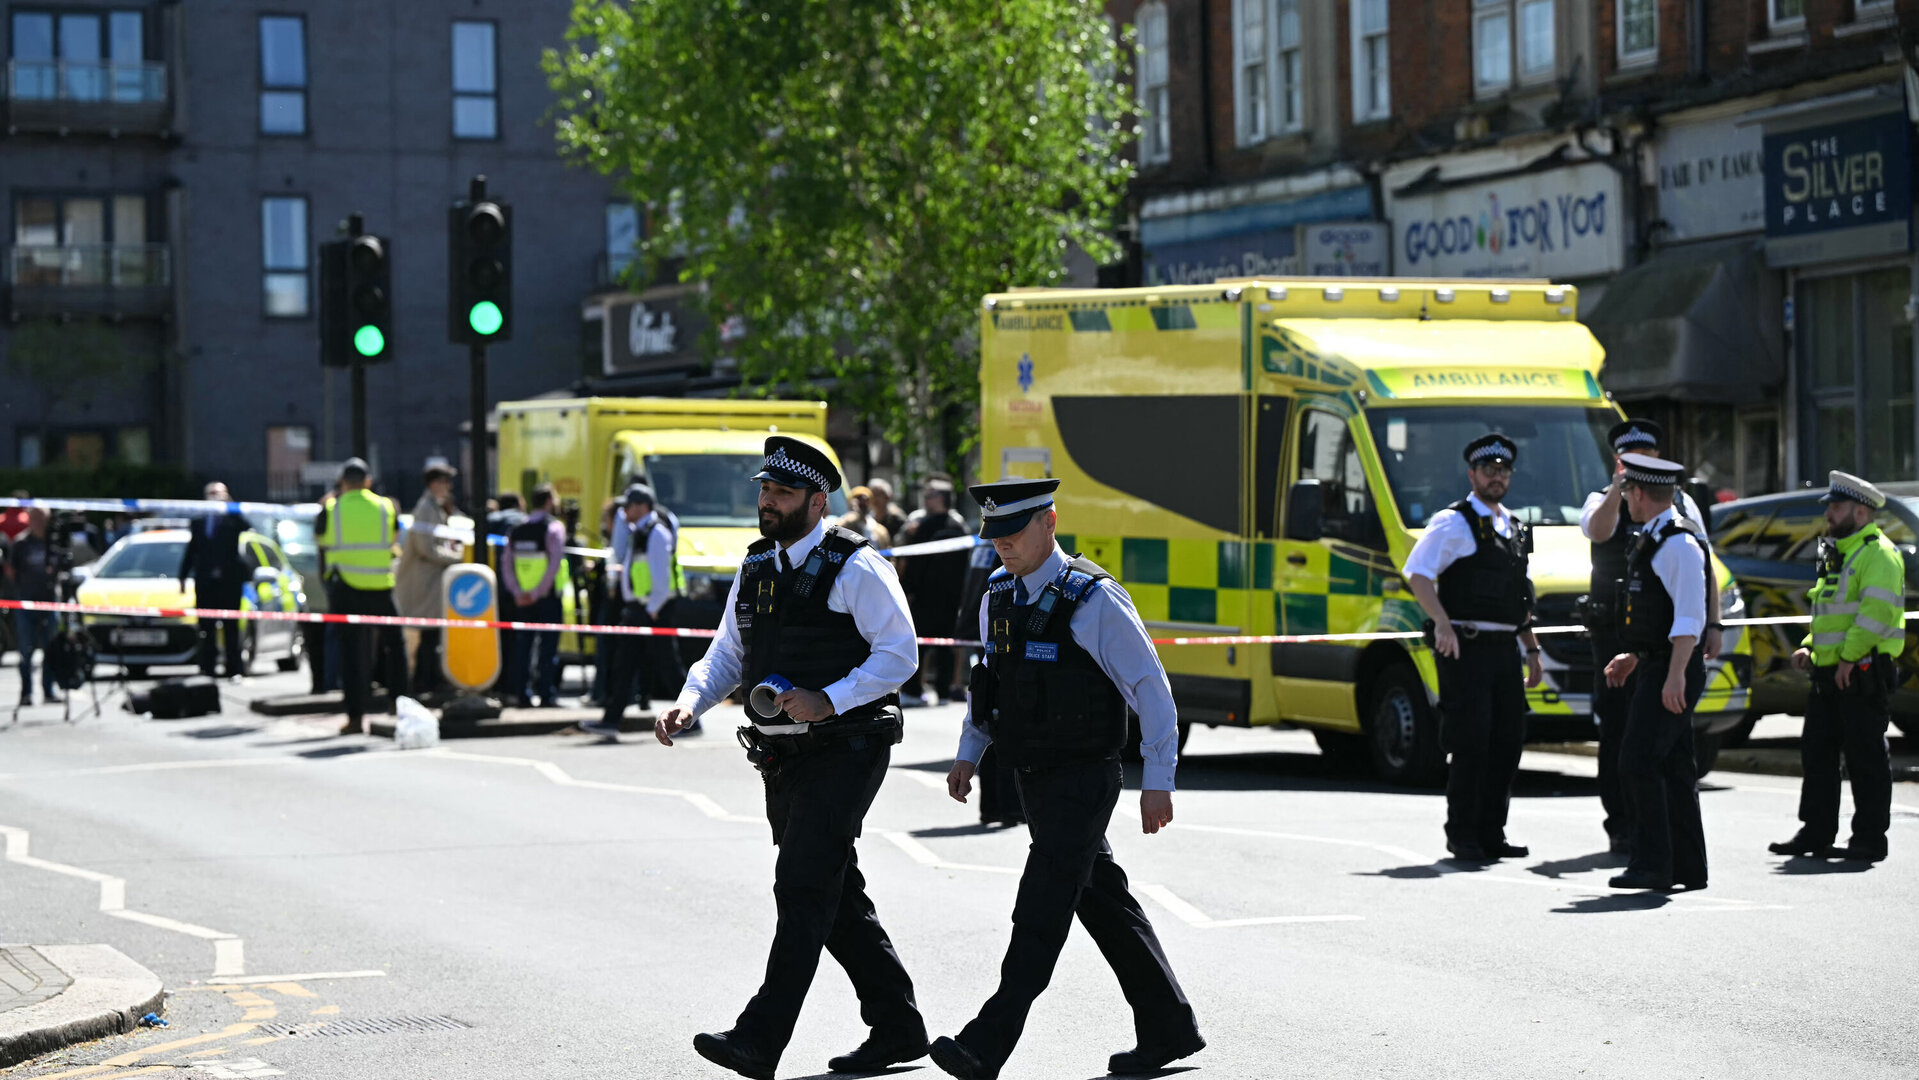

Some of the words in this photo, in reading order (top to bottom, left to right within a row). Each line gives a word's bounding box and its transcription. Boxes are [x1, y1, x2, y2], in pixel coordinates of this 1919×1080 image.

[1812, 137, 1838, 156] THE
[1783, 143, 1884, 202] SILVER
[1783, 192, 1886, 225] PLACE
[1319, 229, 1372, 245] GOOD
[1406, 216, 1473, 264] GOOD
[1506, 200, 1554, 252] FOR
[1557, 191, 1606, 248] YOU
[998, 315, 1065, 331] AMBULANCE
[1414, 373, 1564, 387] AMBULANCE
